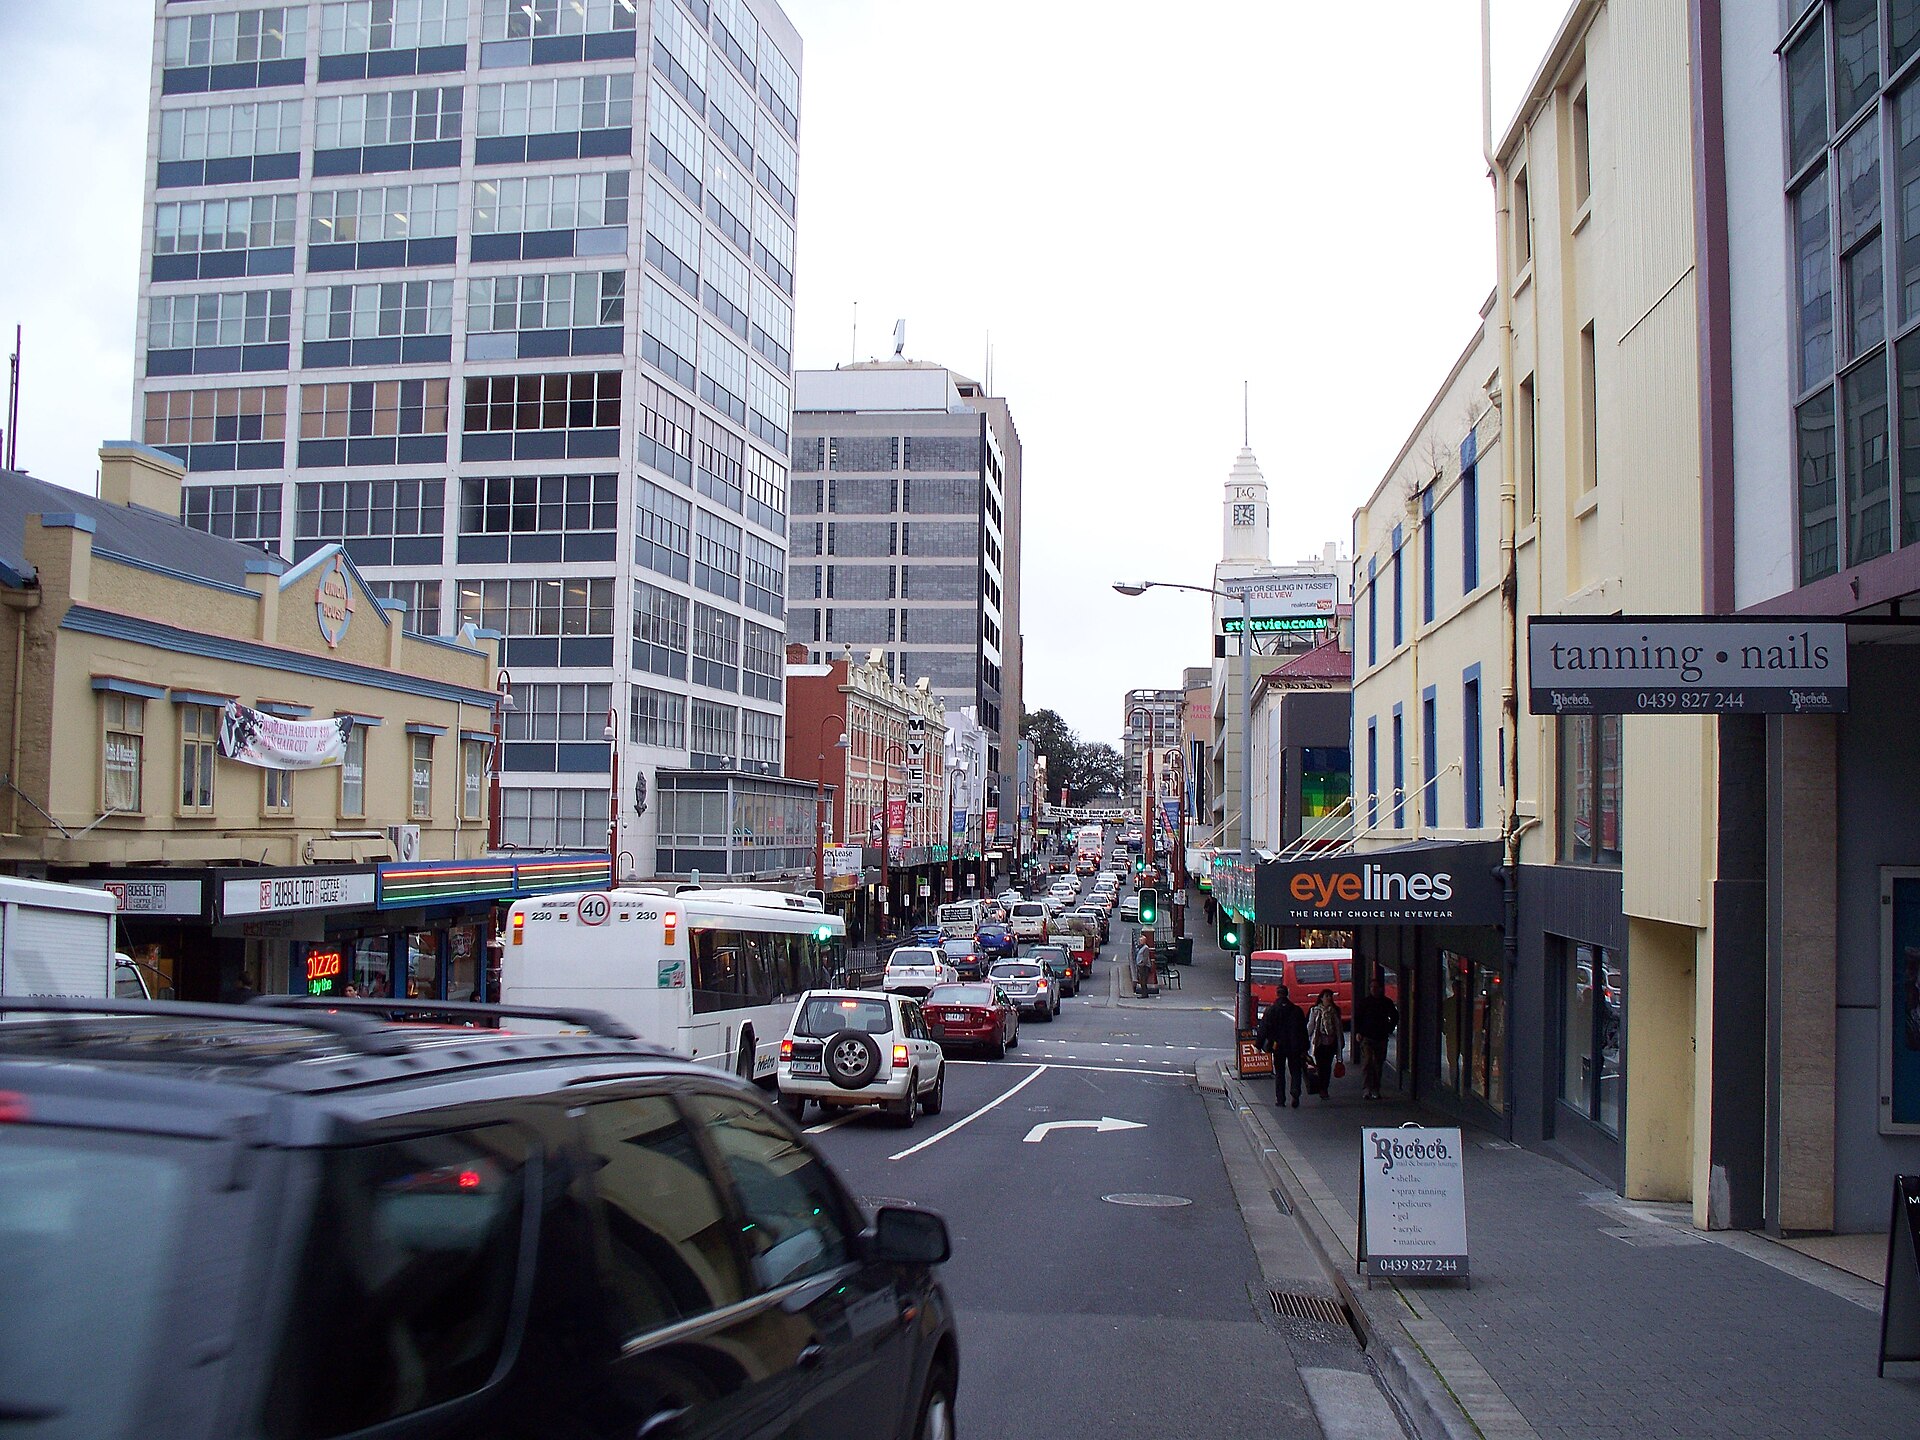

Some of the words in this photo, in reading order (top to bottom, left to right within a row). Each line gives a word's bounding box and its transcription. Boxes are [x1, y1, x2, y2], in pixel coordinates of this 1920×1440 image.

[324, 581, 346, 600] UNION
[1265, 584, 1295, 592] SELLING
[1295, 583, 1304, 591] IN
[1304, 582, 1333, 590] TASSIE?
[322, 602, 345, 621] HOUSE
[1549, 635, 1704, 683] tanning
[1740, 632, 1829, 670] nails
[1637, 692, 1676, 708] 0439
[1680, 692, 1710, 708] 827
[1715, 692, 1745, 708] 244
[262, 720, 289, 736] WOMEN
[305, 726, 318, 739] CUT
[294, 740, 309, 752] CUT
[908, 719, 925, 804] MYER
[834, 849, 853, 857] Lease
[320, 878, 340, 890] COFFEE
[1290, 864, 1453, 908] eyelines
[128, 885, 152, 897] BUBBLE
[153, 885, 165, 897] TEA
[274, 881, 300, 907] BUBBLE
[301, 879, 314, 905] TEA
[320, 890, 339, 903] HOUSE
[582, 901, 606, 917] 40
[1290, 910, 1309, 918] THE
[1313, 910, 1343, 918] RIGHT
[1347, 910, 1386, 918] CHOICE
[1389, 910, 1400, 918] IN
[1404, 910, 1453, 918] EYEWEAR
[531, 912, 552, 921] 230
[636, 911, 658, 920] 230
[1396, 1174, 1421, 1182] shellac
[1397, 1188, 1416, 1197] spray
[1418, 1188, 1447, 1197] tanning
[1397, 1200, 1432, 1210] pedicures
[1397, 1212, 1409, 1222] gel
[1398, 1226, 1423, 1235] acrylic
[1398, 1238, 1436, 1246] manicures
[1380, 1259, 1409, 1271] 0439
[1411, 1259, 1433, 1271] 827
[1435, 1259, 1457, 1271] 244
